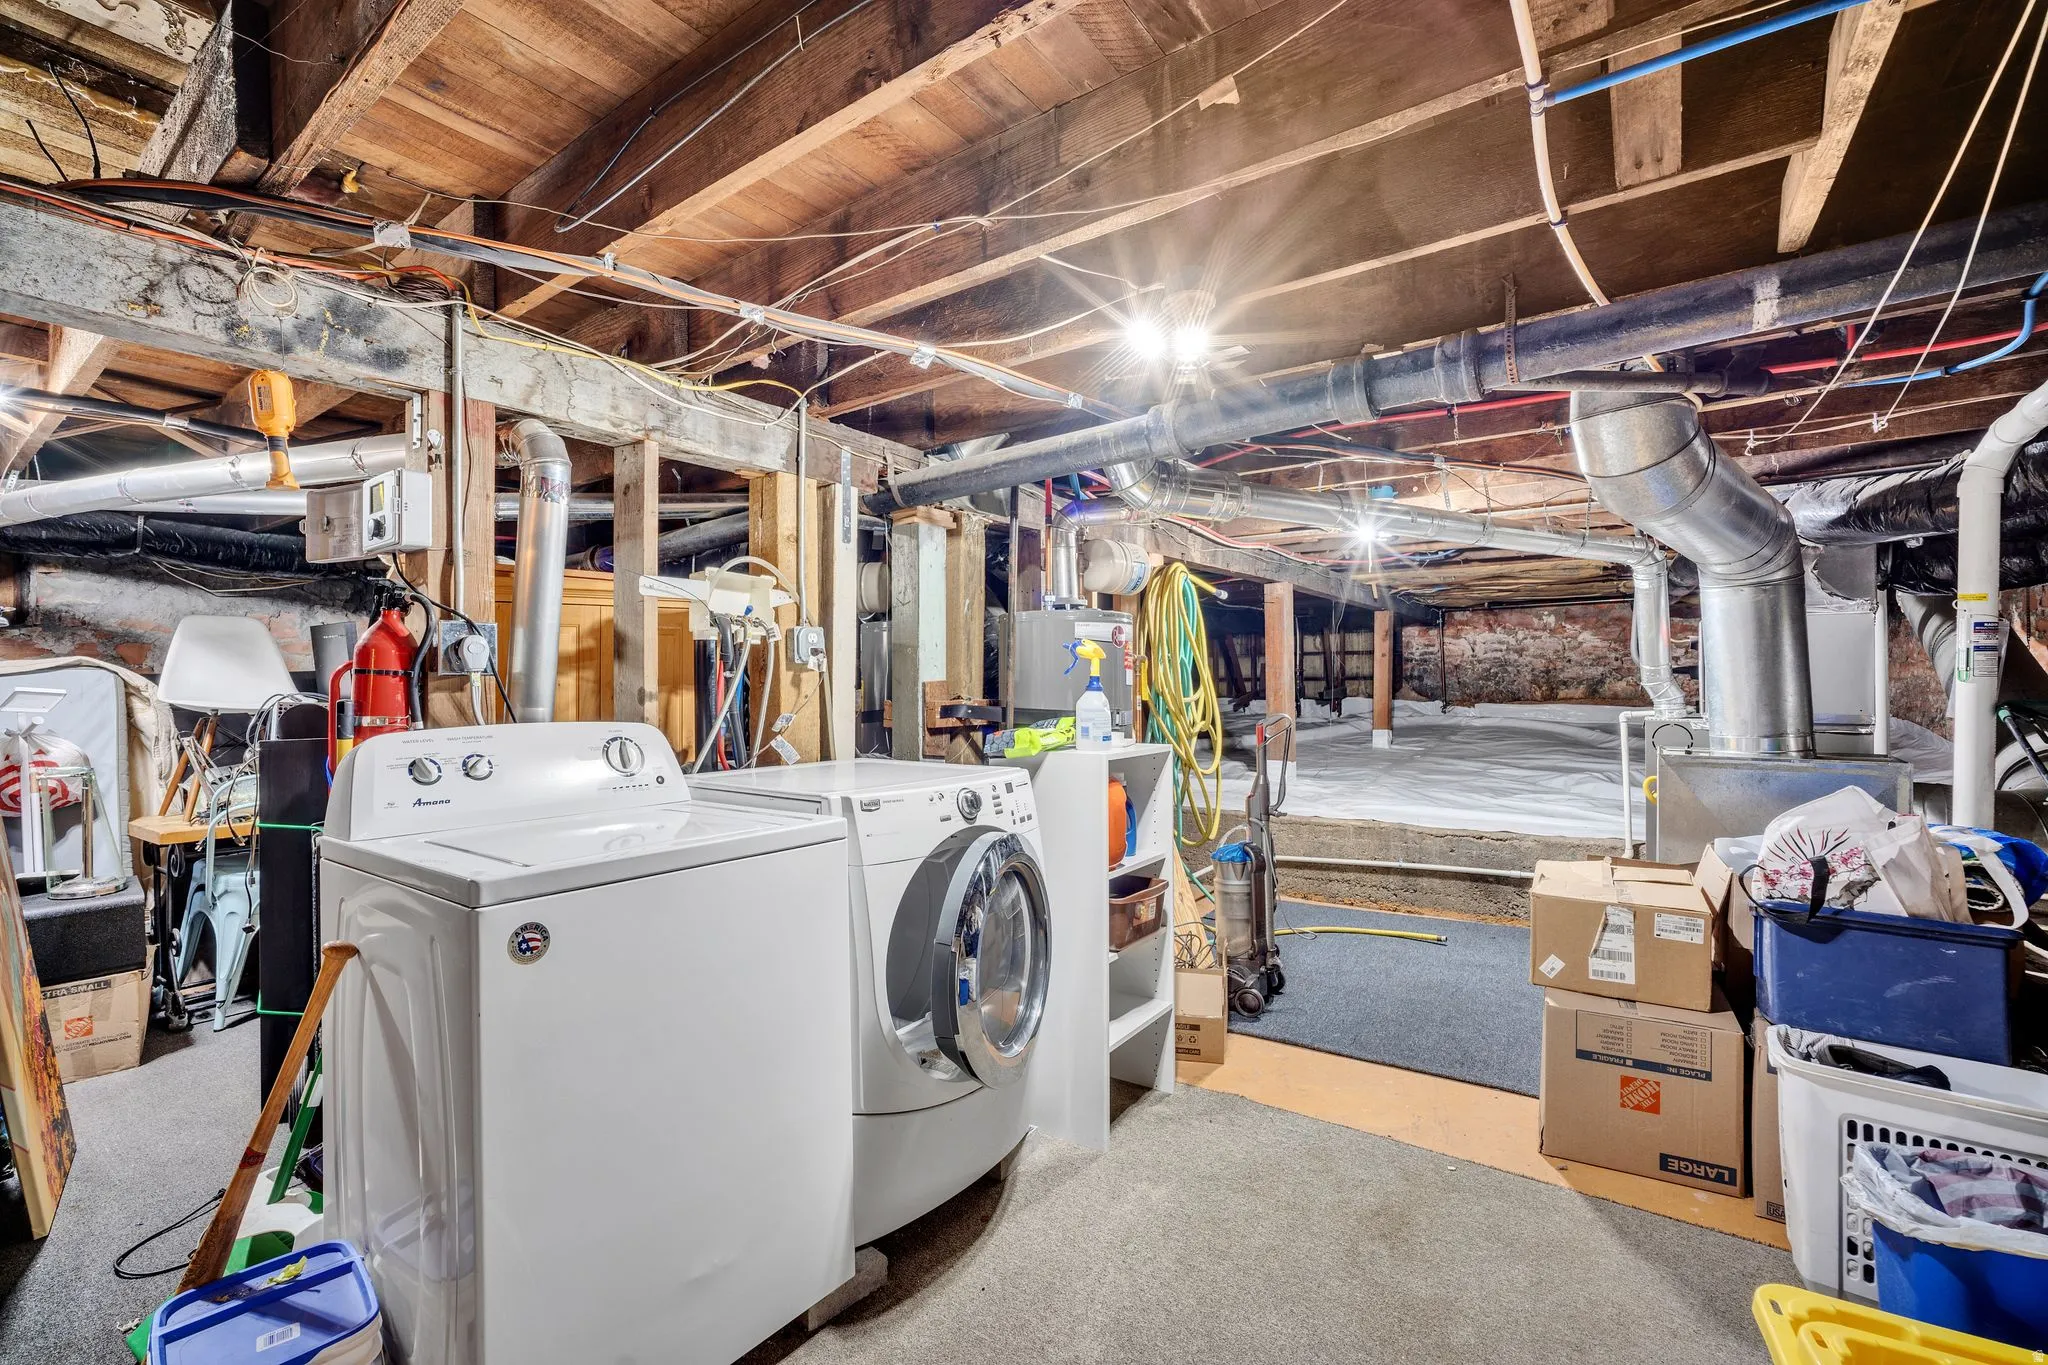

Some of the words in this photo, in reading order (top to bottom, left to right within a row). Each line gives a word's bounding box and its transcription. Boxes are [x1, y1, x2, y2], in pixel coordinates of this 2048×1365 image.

[412, 798, 451, 808] Amana
[515, 924, 548, 942] AMERICA
[40, 988, 68, 999] XTRA
[70, 981, 107, 994] SMALL
[1592, 1054, 1624, 1064] FRAGILE
[1680, 1068, 1706, 1079] PLACE
[1620, 1079, 1644, 1095] DEPOT
[1620, 1081, 1660, 1110] HOME
[1640, 1097, 1656, 1109] THE
[1668, 1158, 1729, 1182] LARGE
